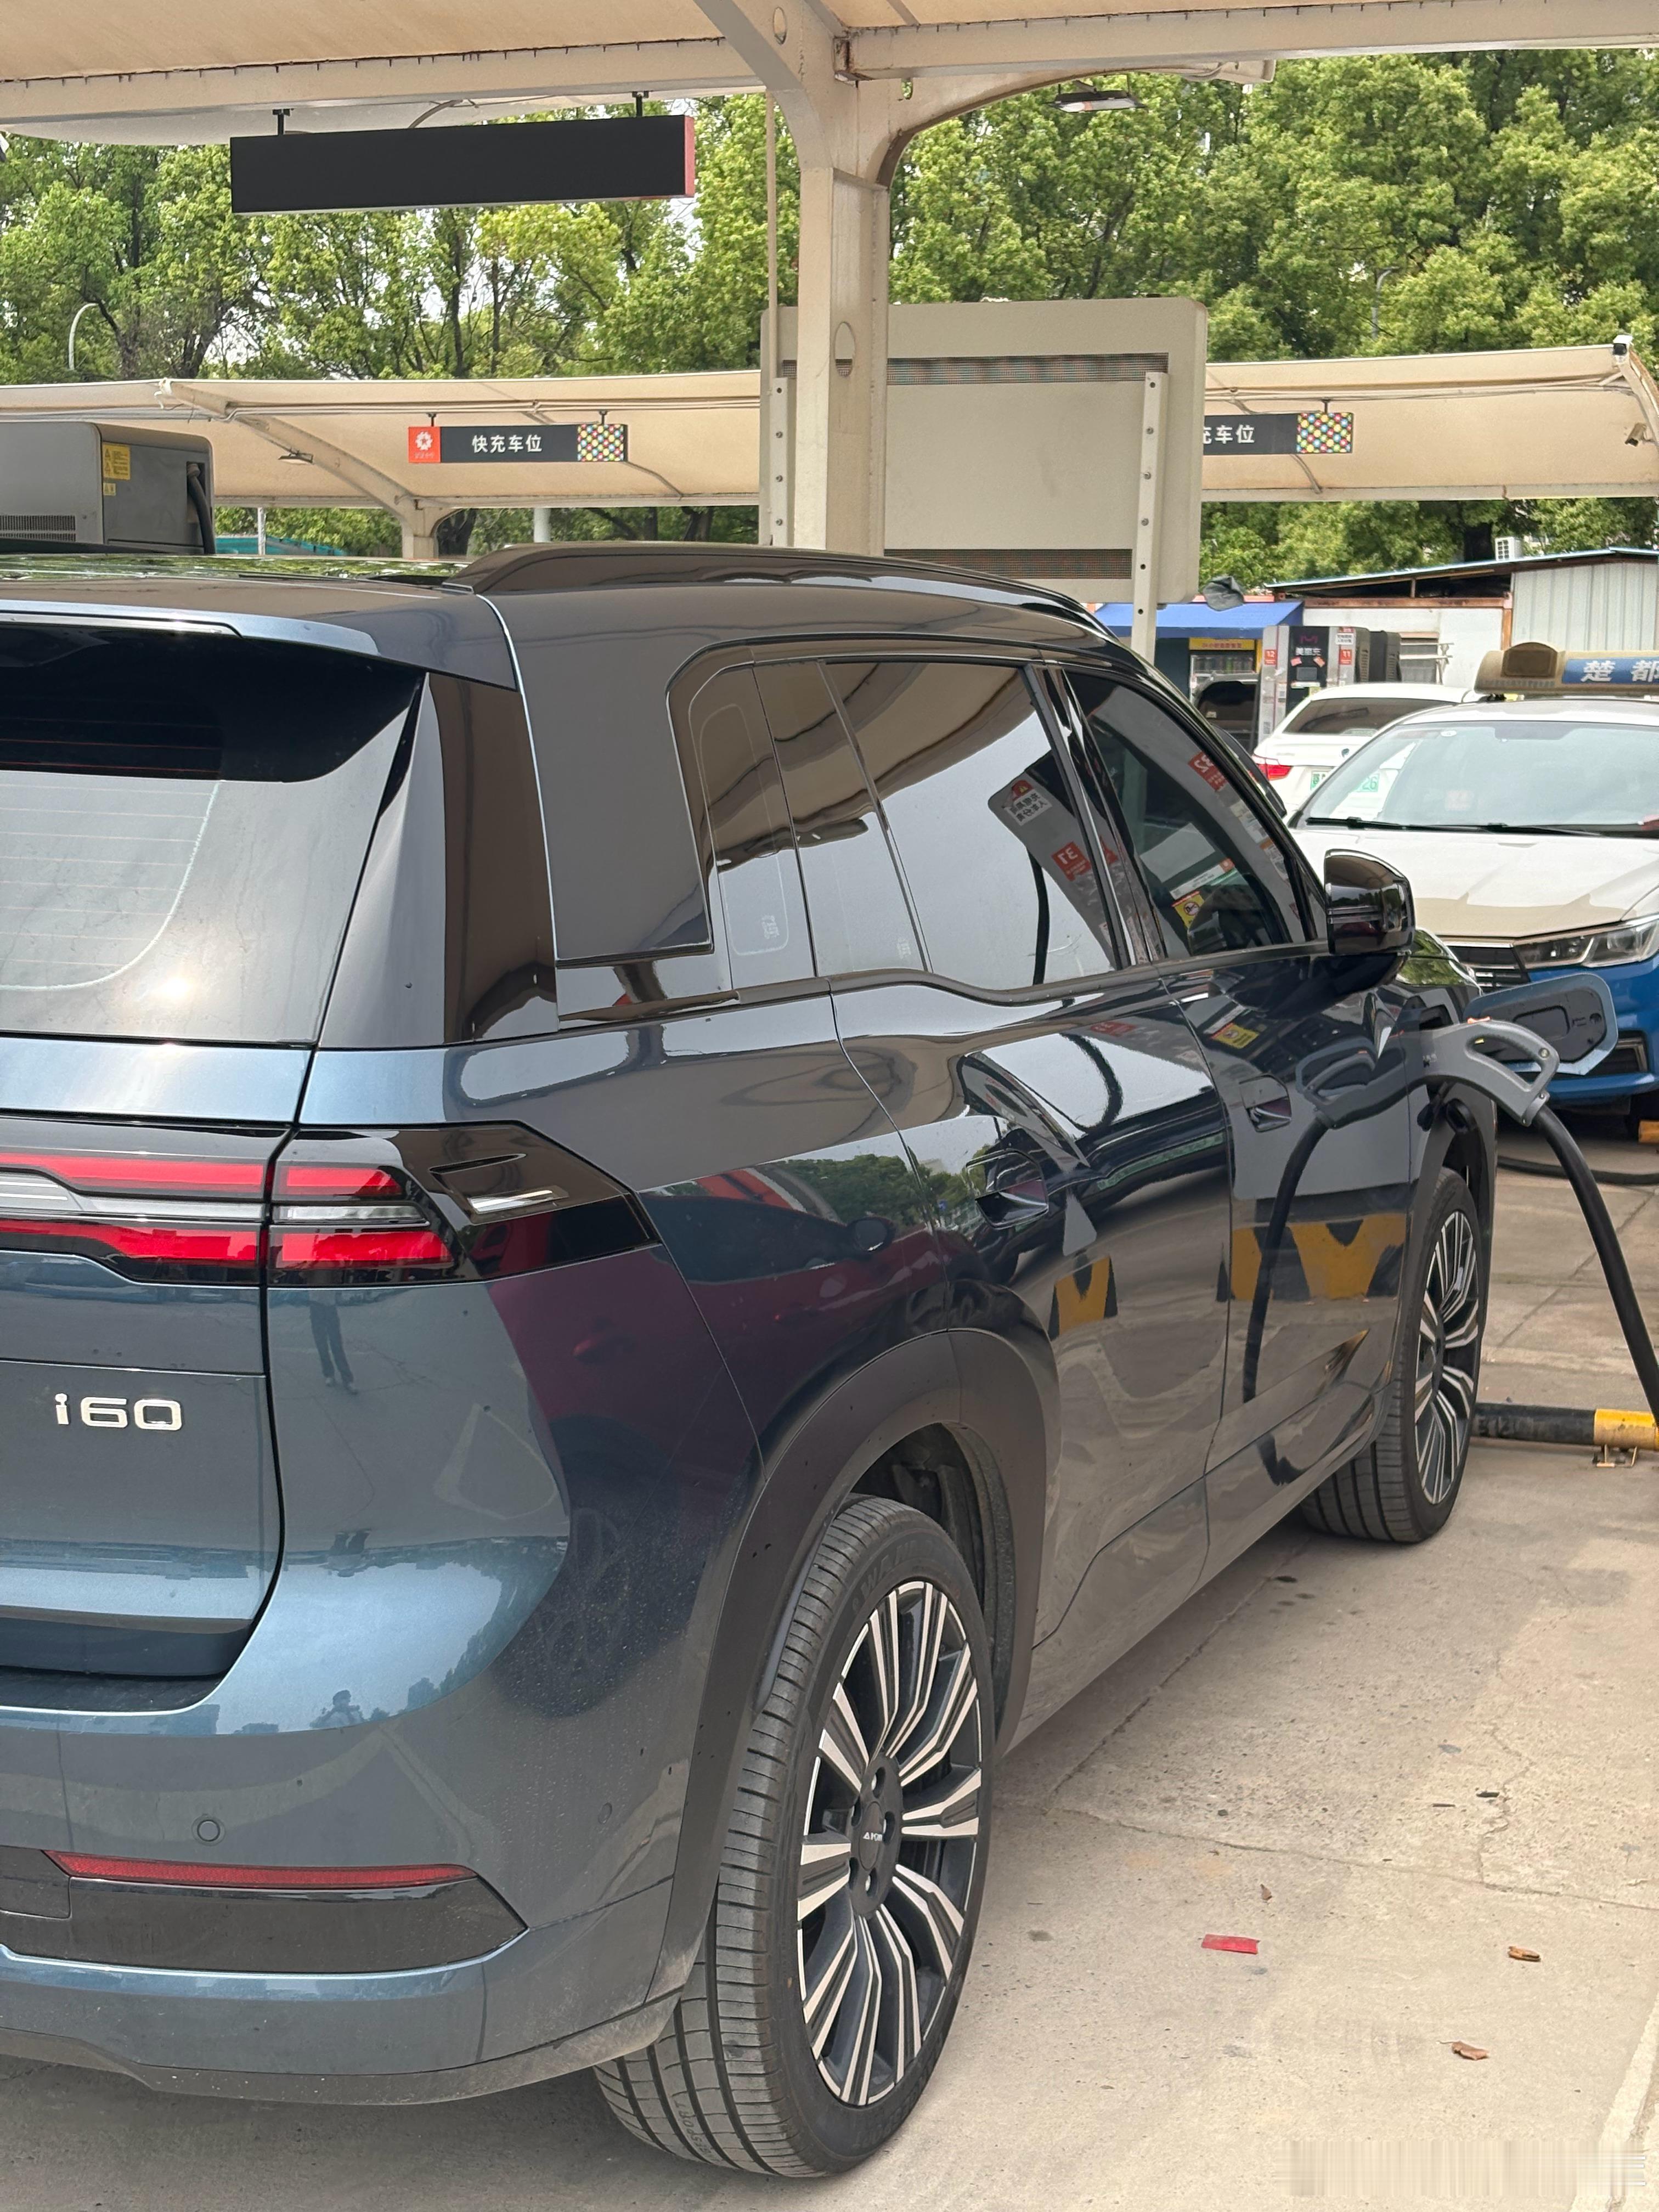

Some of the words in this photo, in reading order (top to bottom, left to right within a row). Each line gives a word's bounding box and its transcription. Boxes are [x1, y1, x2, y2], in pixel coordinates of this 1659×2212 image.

[472, 435, 543, 454] 快充车位
[55, 1393, 182, 1431] i60
